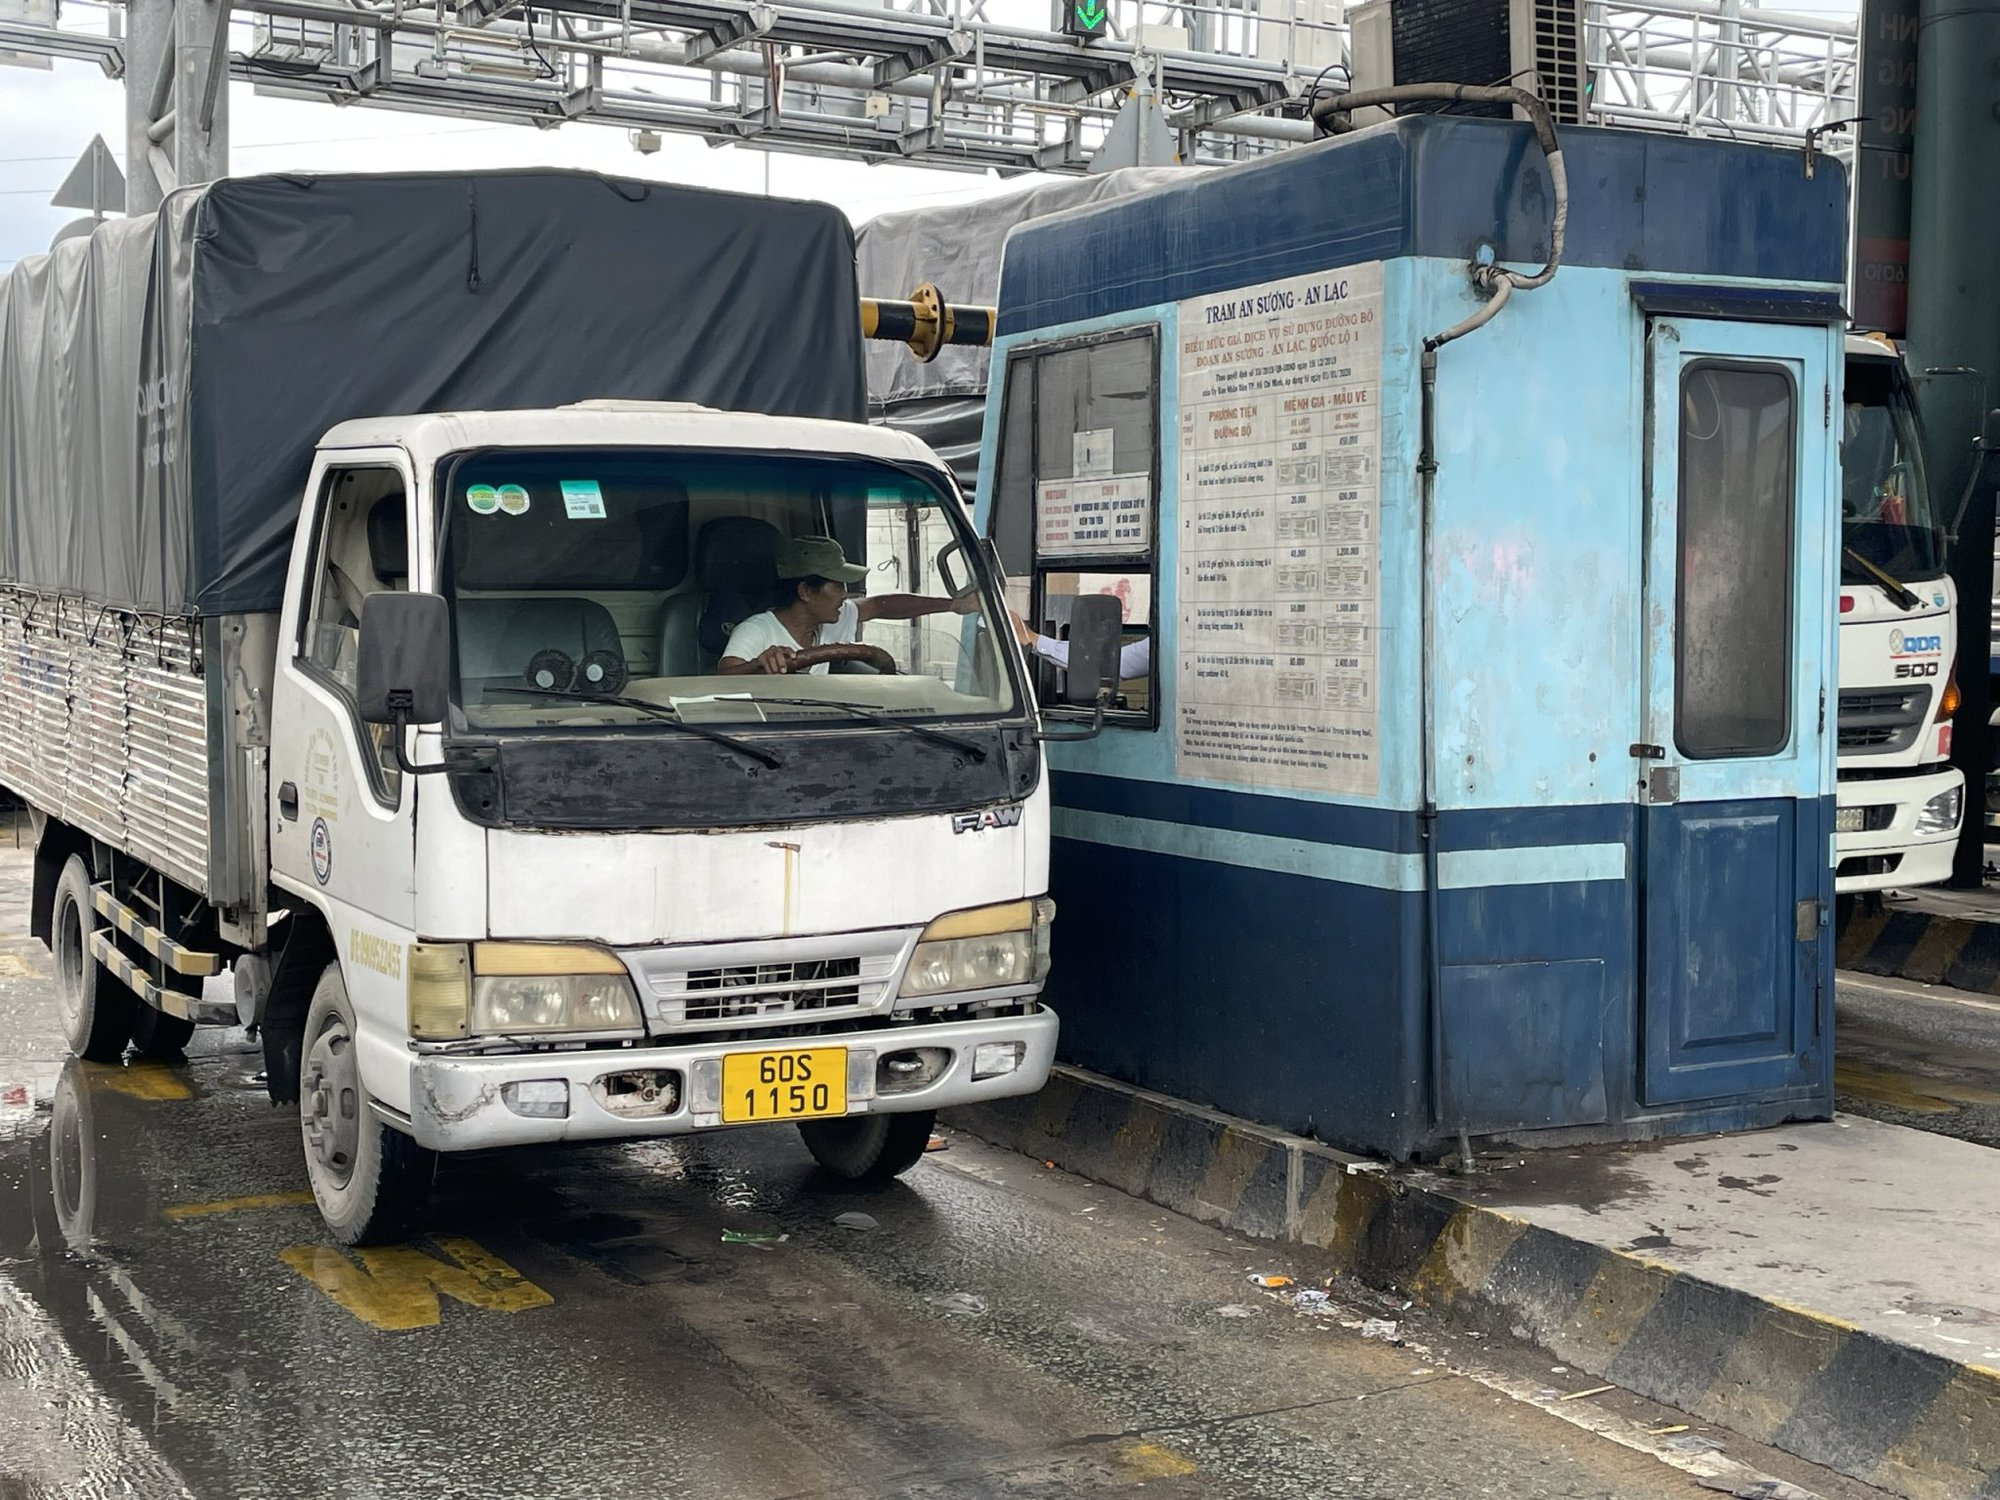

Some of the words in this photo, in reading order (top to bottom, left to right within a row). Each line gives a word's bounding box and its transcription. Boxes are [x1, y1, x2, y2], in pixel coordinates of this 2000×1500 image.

[1206, 302, 1236, 325] TRẠM
[1239, 299, 1254, 318] AN
[1257, 291, 1294, 314] SƯƠNG
[1304, 286, 1320, 305] AN
[1324, 280, 1348, 305] LẠC
[1222, 351, 1234, 364] AN
[1272, 343, 1285, 356] AN
[1894, 662, 1938, 679] 500
[951, 807, 1023, 834] FAW
[760, 1054, 812, 1083] 60S
[745, 1084, 828, 1117] 1150
